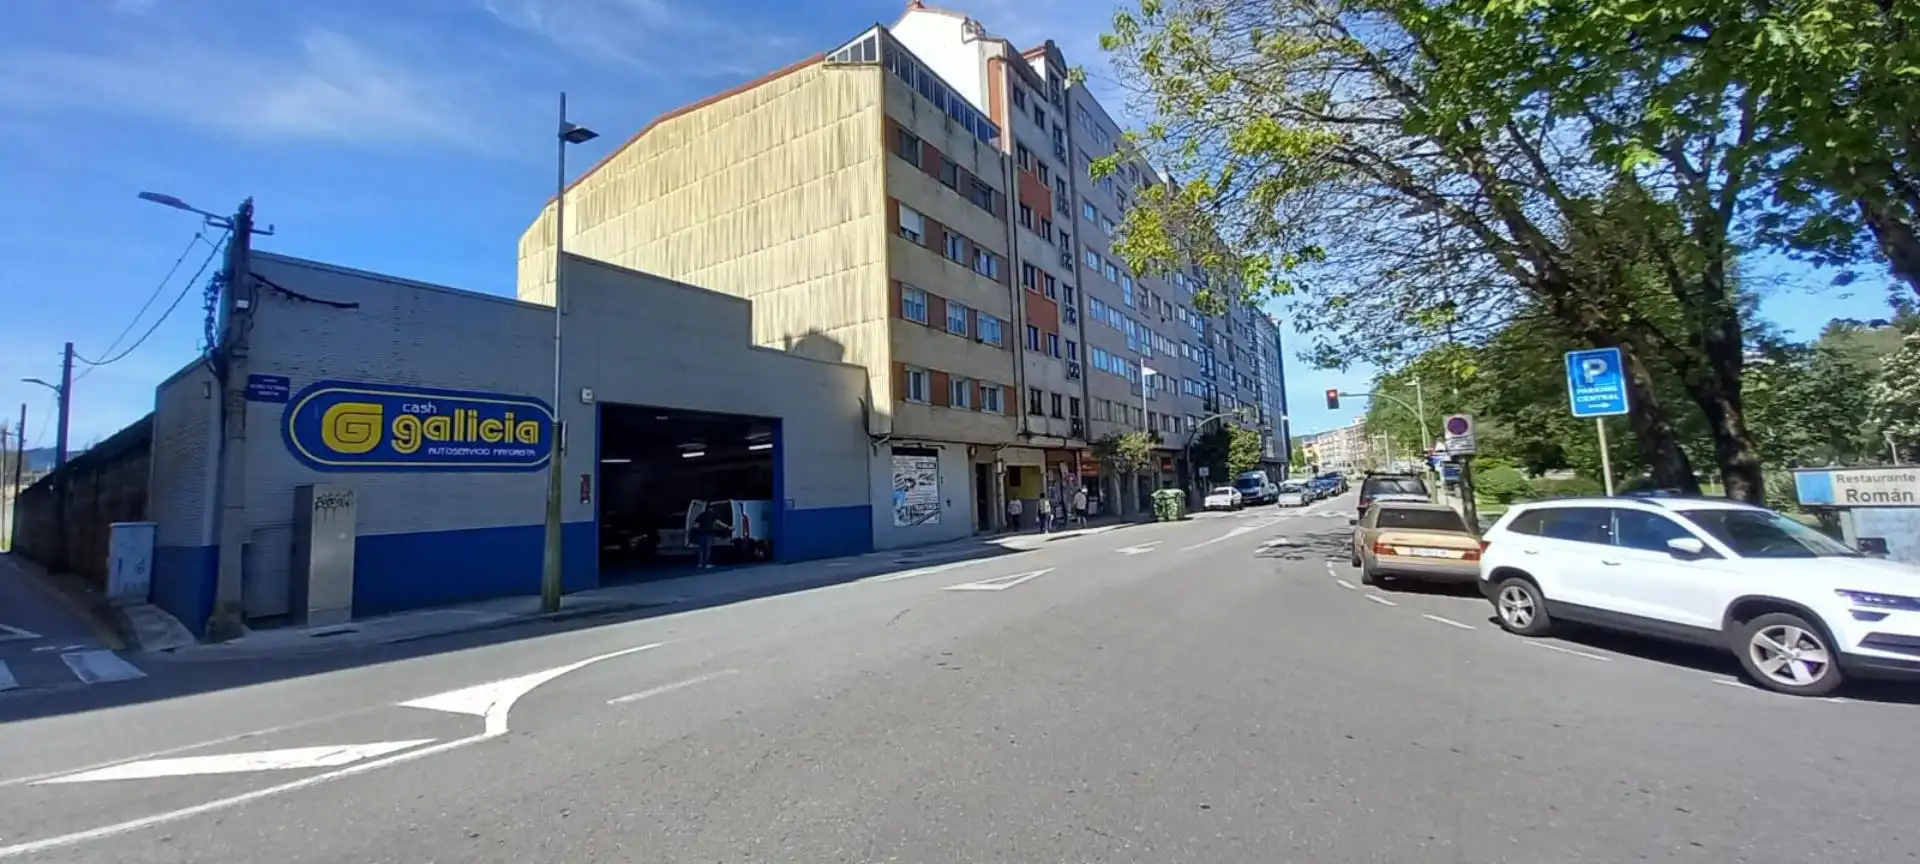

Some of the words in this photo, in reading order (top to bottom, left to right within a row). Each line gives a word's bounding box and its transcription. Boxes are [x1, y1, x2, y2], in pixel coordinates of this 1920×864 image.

[1582, 358, 1608, 383] P
[1576, 394, 1620, 403] CENTRAL
[402, 401, 437, 414] cash
[391, 408, 540, 454] galicia
[428, 447, 491, 457] AUTOSERVICIO
[493, 448, 536, 457] MAYORISTA
[1836, 473, 1916, 484] Restaurante
[1846, 488, 1914, 503] Román
